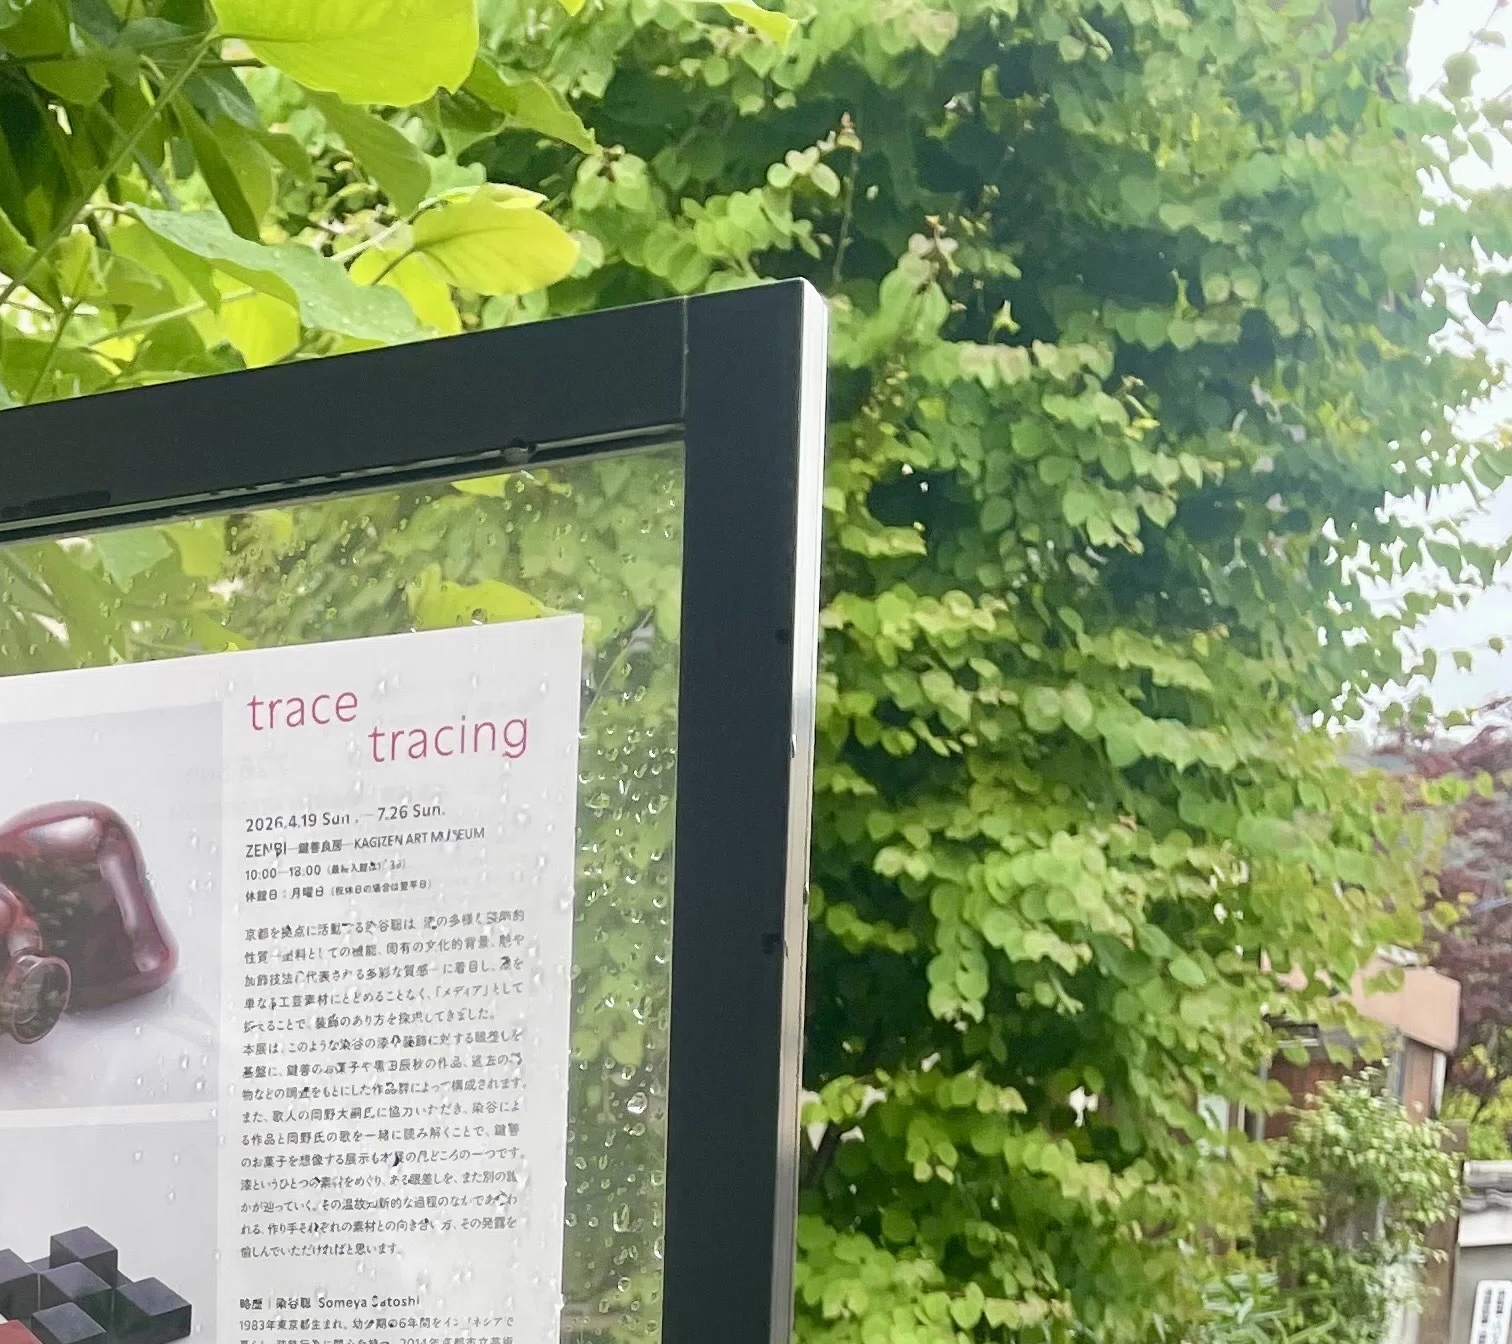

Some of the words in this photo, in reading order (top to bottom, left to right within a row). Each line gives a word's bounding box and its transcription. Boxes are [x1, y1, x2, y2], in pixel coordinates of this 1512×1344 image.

[247, 692, 358, 731] trace
[368, 715, 528, 763] tracing
[405, 831, 428, 844] ART
[318, 1297, 367, 1311] Someya
